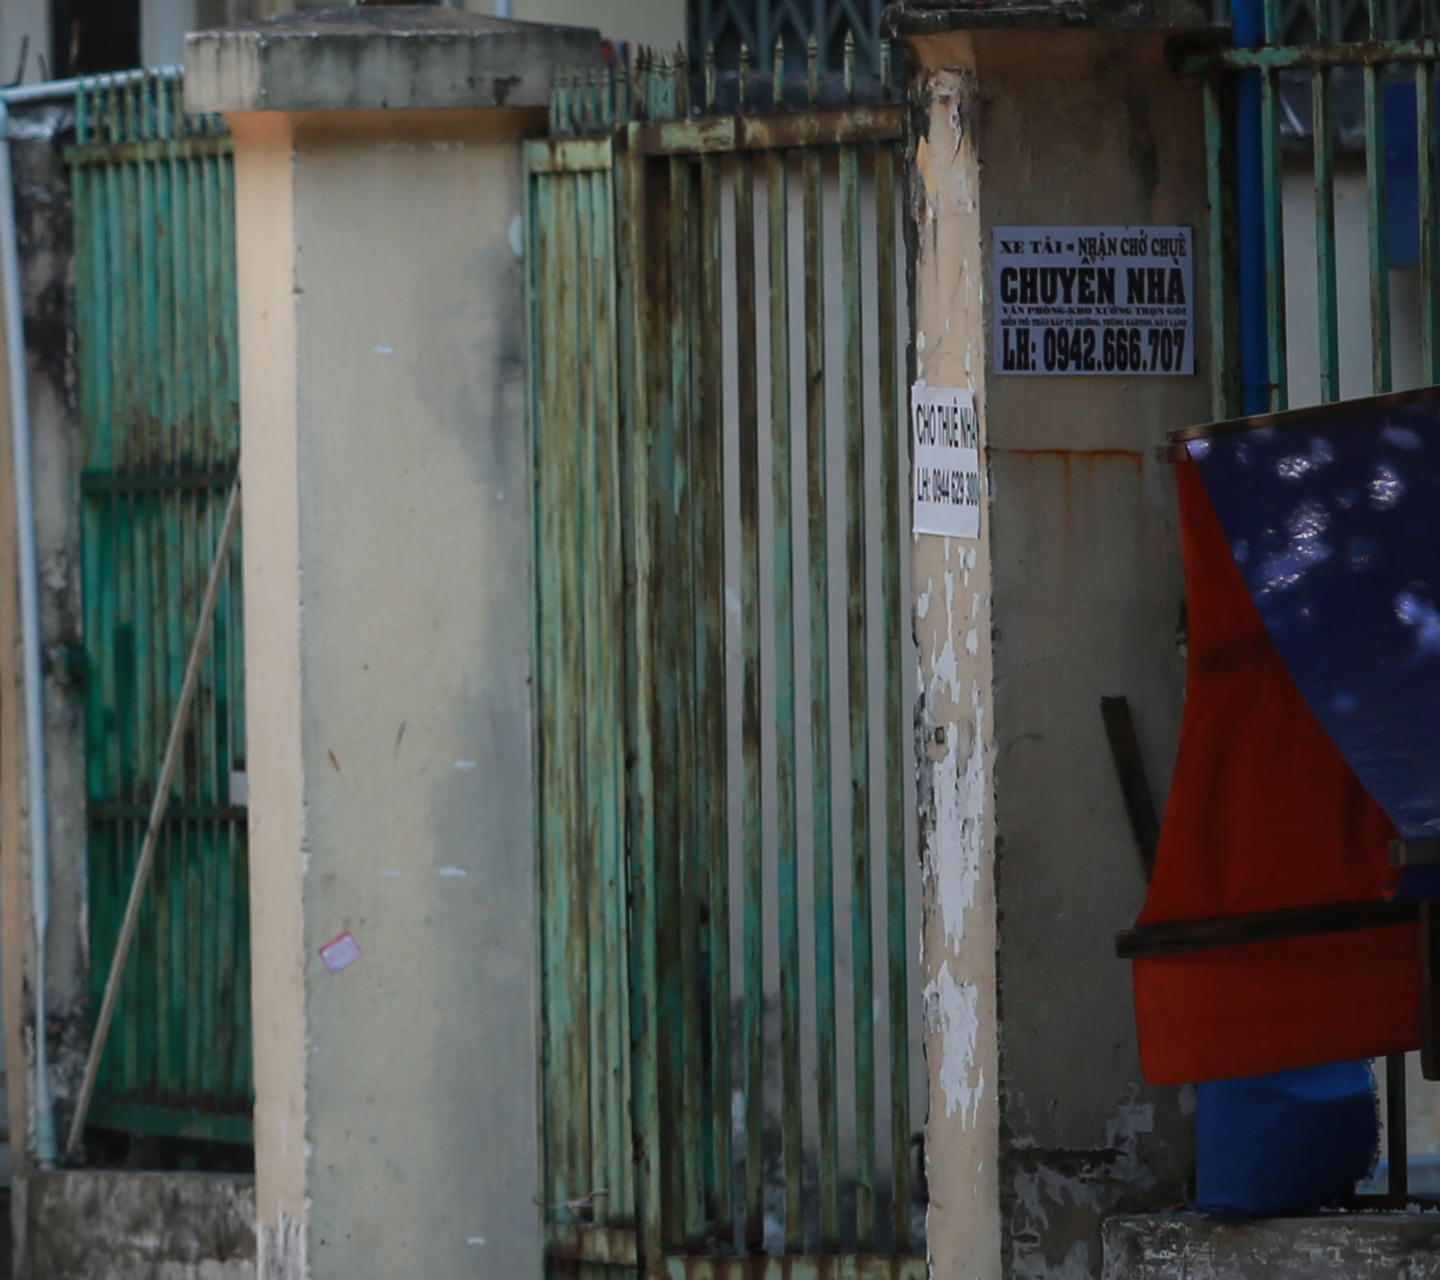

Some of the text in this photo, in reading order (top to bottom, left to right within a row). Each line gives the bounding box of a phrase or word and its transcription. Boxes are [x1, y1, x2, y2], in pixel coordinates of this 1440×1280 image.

[1000, 240, 1025, 254] XE
[1030, 236, 1062, 254] TẢI
[1078, 231, 1117, 261] NHẬN
[1000, 257, 1186, 305] CHUYỂN NHÀ
[1003, 327, 1186, 372] LH: 0942.666.707
